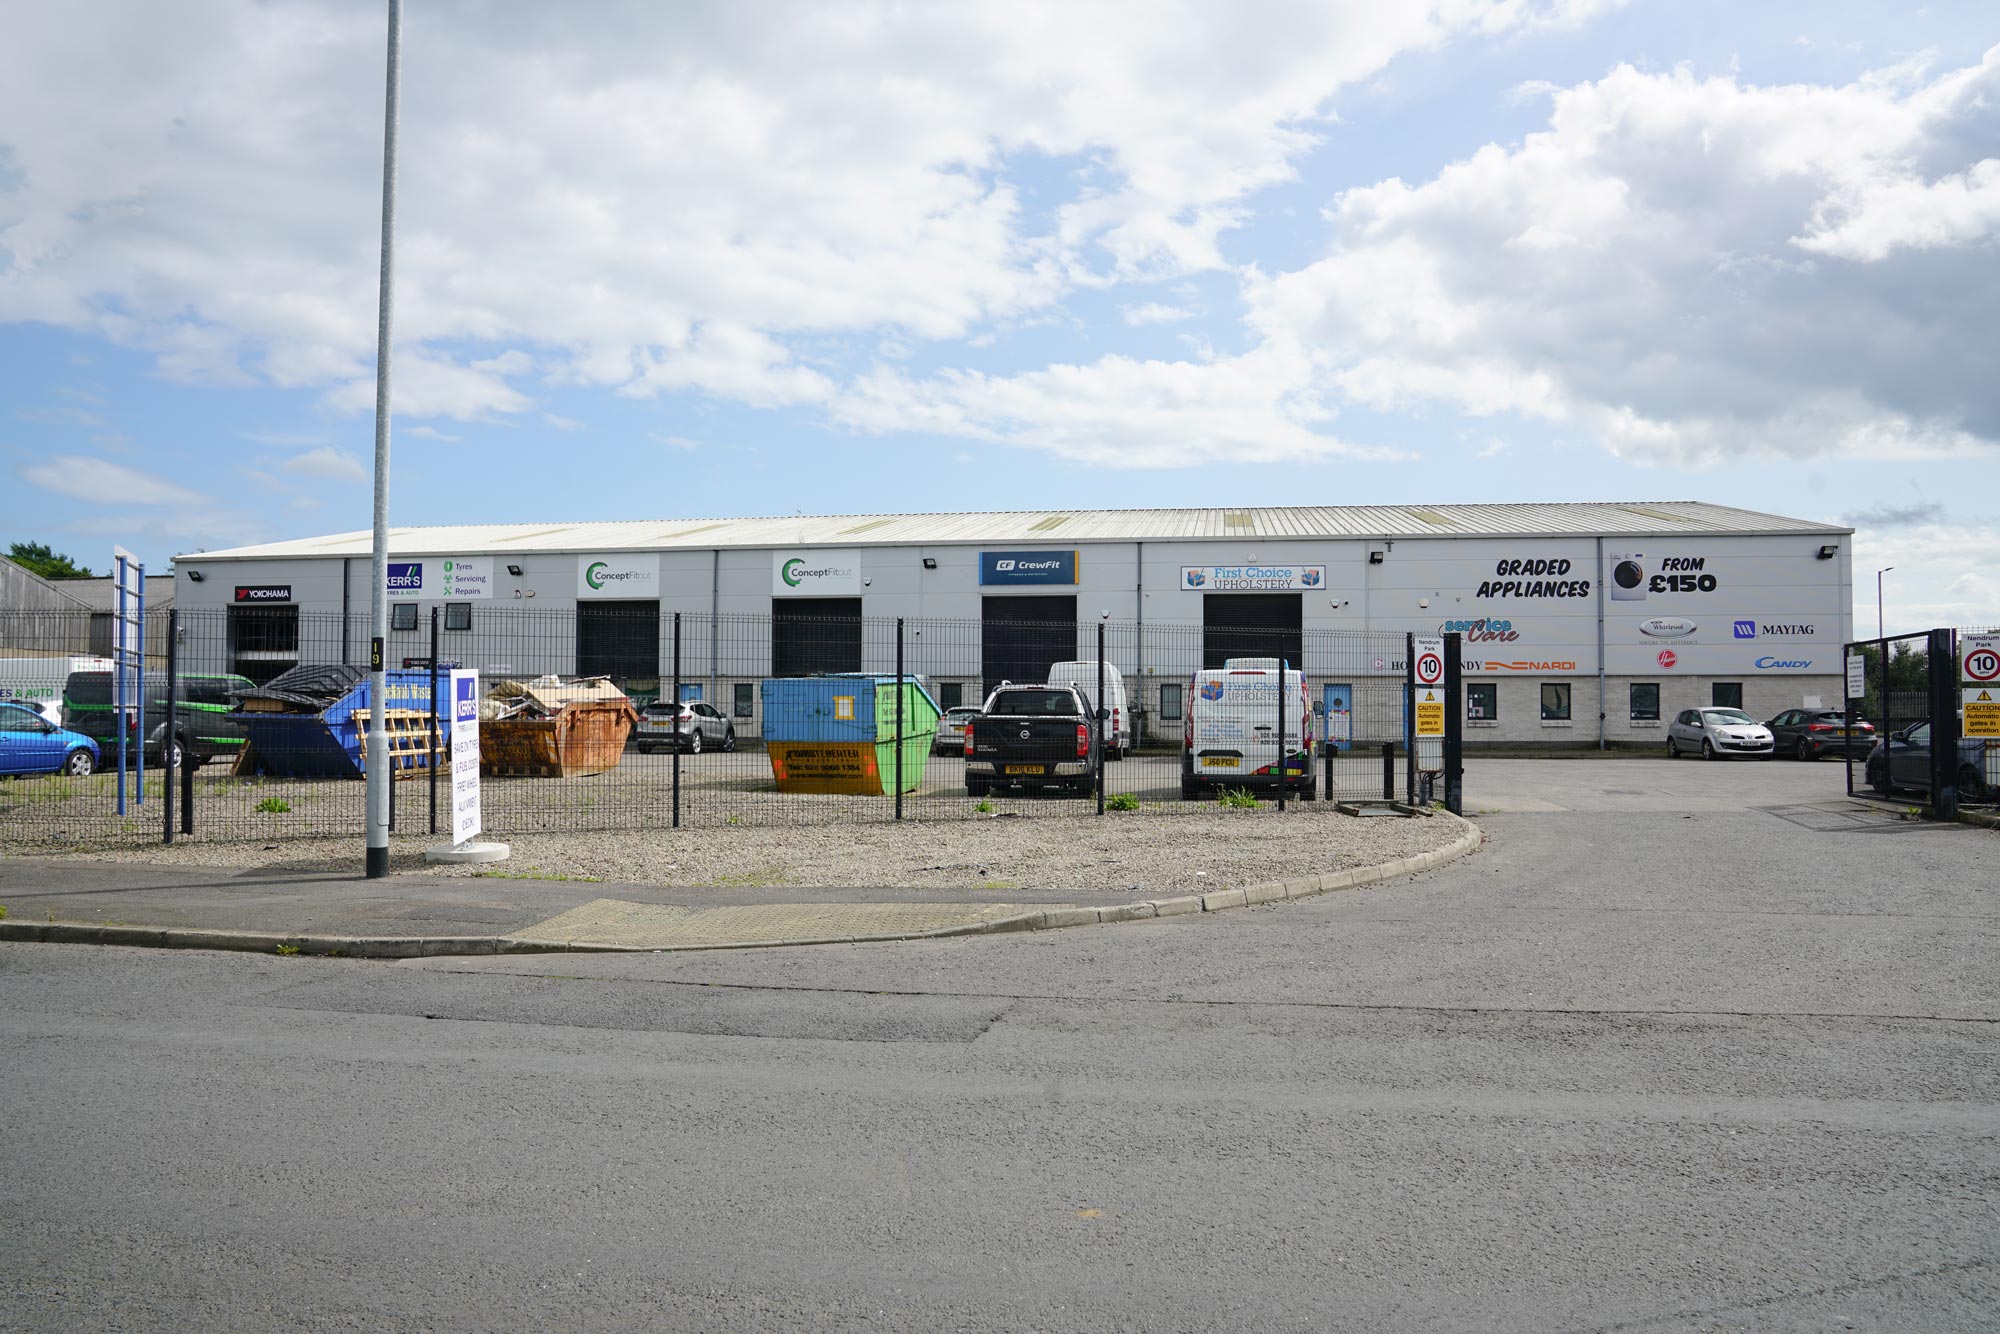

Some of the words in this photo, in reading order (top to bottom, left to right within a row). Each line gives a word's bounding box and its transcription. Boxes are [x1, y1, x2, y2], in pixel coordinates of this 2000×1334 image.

[456, 563, 473, 573] Tyres
[1000, 561, 1012, 569] CF
[1018, 561, 1060, 569] CrewFit
[1496, 559, 1571, 576] GRADED
[1662, 557, 1705, 571] FROM
[595, 571, 651, 581] ConceptFitout
[792, 568, 852, 579] ConceptFitout
[1214, 568, 1242, 578] First
[1245, 568, 1292, 578] Choice
[455, 576, 486, 584] Servicing
[1214, 580, 1293, 589] UPHOLSTERY
[1648, 574, 1717, 593] £150
[249, 590, 289, 598] YOKOHAMA
[455, 587, 481, 596] Repairs
[1476, 580, 1590, 598] APPLIANCES
[1467, 619, 1520, 643] Care
[1762, 624, 1814, 635] MAYTAG
[1422, 659, 1437, 674] 10
[1529, 661, 1576, 670] NARDI
[1755, 656, 1813, 669] CANDY
[1973, 656, 1995, 671] 10
[1254, 682, 1292, 691] Choie
[15, 689, 23, 697] &
[27, 688, 54, 697] AUTO
[1228, 692, 1291, 701] UPHOLSTEY
